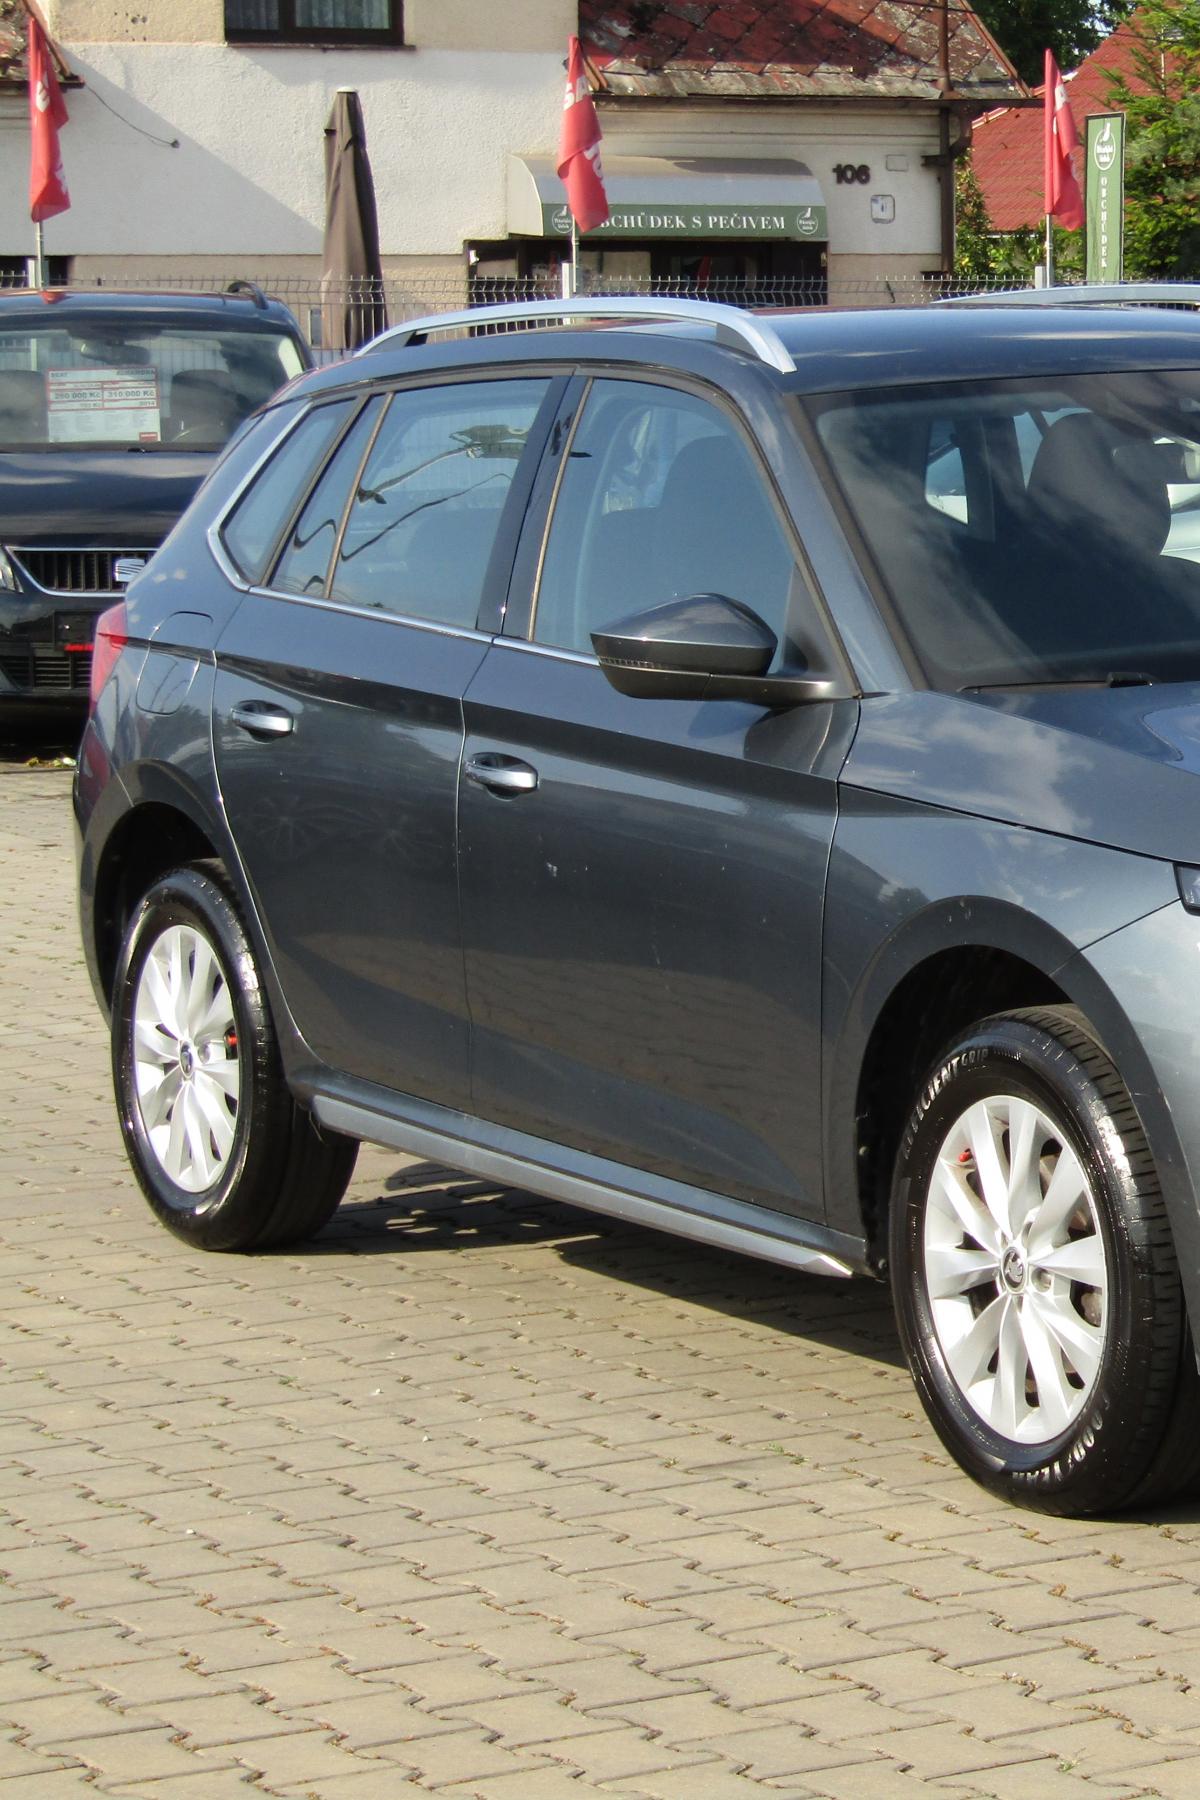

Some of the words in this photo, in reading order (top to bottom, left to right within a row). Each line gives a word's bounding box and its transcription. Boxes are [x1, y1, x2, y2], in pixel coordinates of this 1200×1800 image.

[832, 164, 871, 185] 106
[692, 215, 702, 229] S
[708, 212, 785, 230] PEČIVEM
